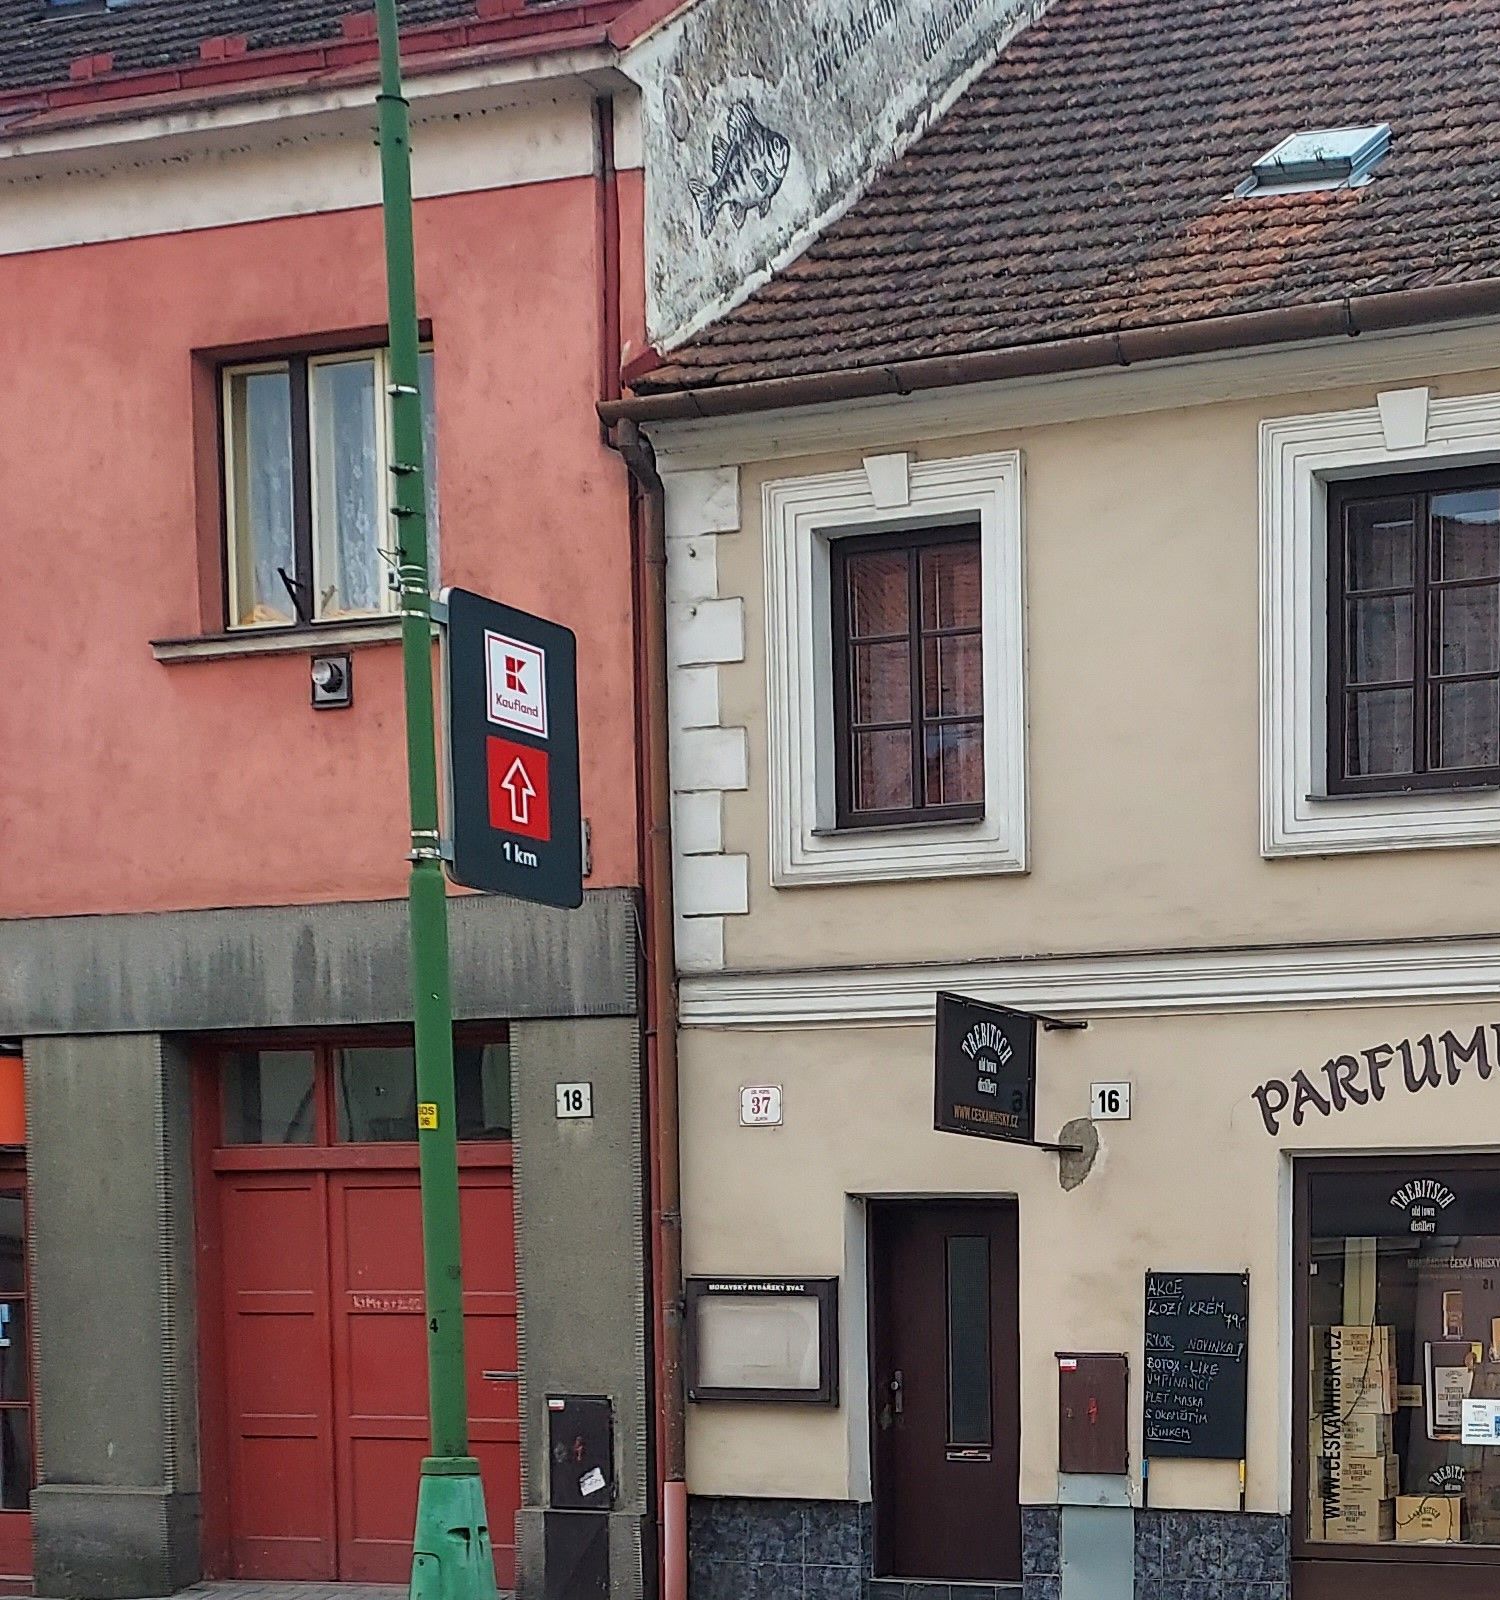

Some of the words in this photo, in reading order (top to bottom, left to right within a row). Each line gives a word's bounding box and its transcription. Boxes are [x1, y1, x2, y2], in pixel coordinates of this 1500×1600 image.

[495, 692, 539, 718] Kaufland
[503, 841, 512, 861] 1
[514, 843, 539, 868] km
[961, 1022, 1013, 1066] TREBITSCH
[563, 1089, 583, 1112] 18
[751, 1096, 771, 1115] 37
[1098, 1089, 1120, 1114] 16
[1390, 1180, 1456, 1209] TREBITSCH
[708, 1282, 747, 1291] MORAVSKÝ
[785, 1283, 805, 1291] SVAZ
[1147, 1278, 1183, 1296] AKCE
[1147, 1294, 1185, 1316] KOZÍ
[1188, 1296, 1225, 1315] KRÉM
[429, 1317, 439, 1333] 4
[1145, 1332, 1175, 1349] RYOR
[1146, 1356, 1180, 1372] BOTOX
[1173, 1394, 1204, 1407] MASKA
